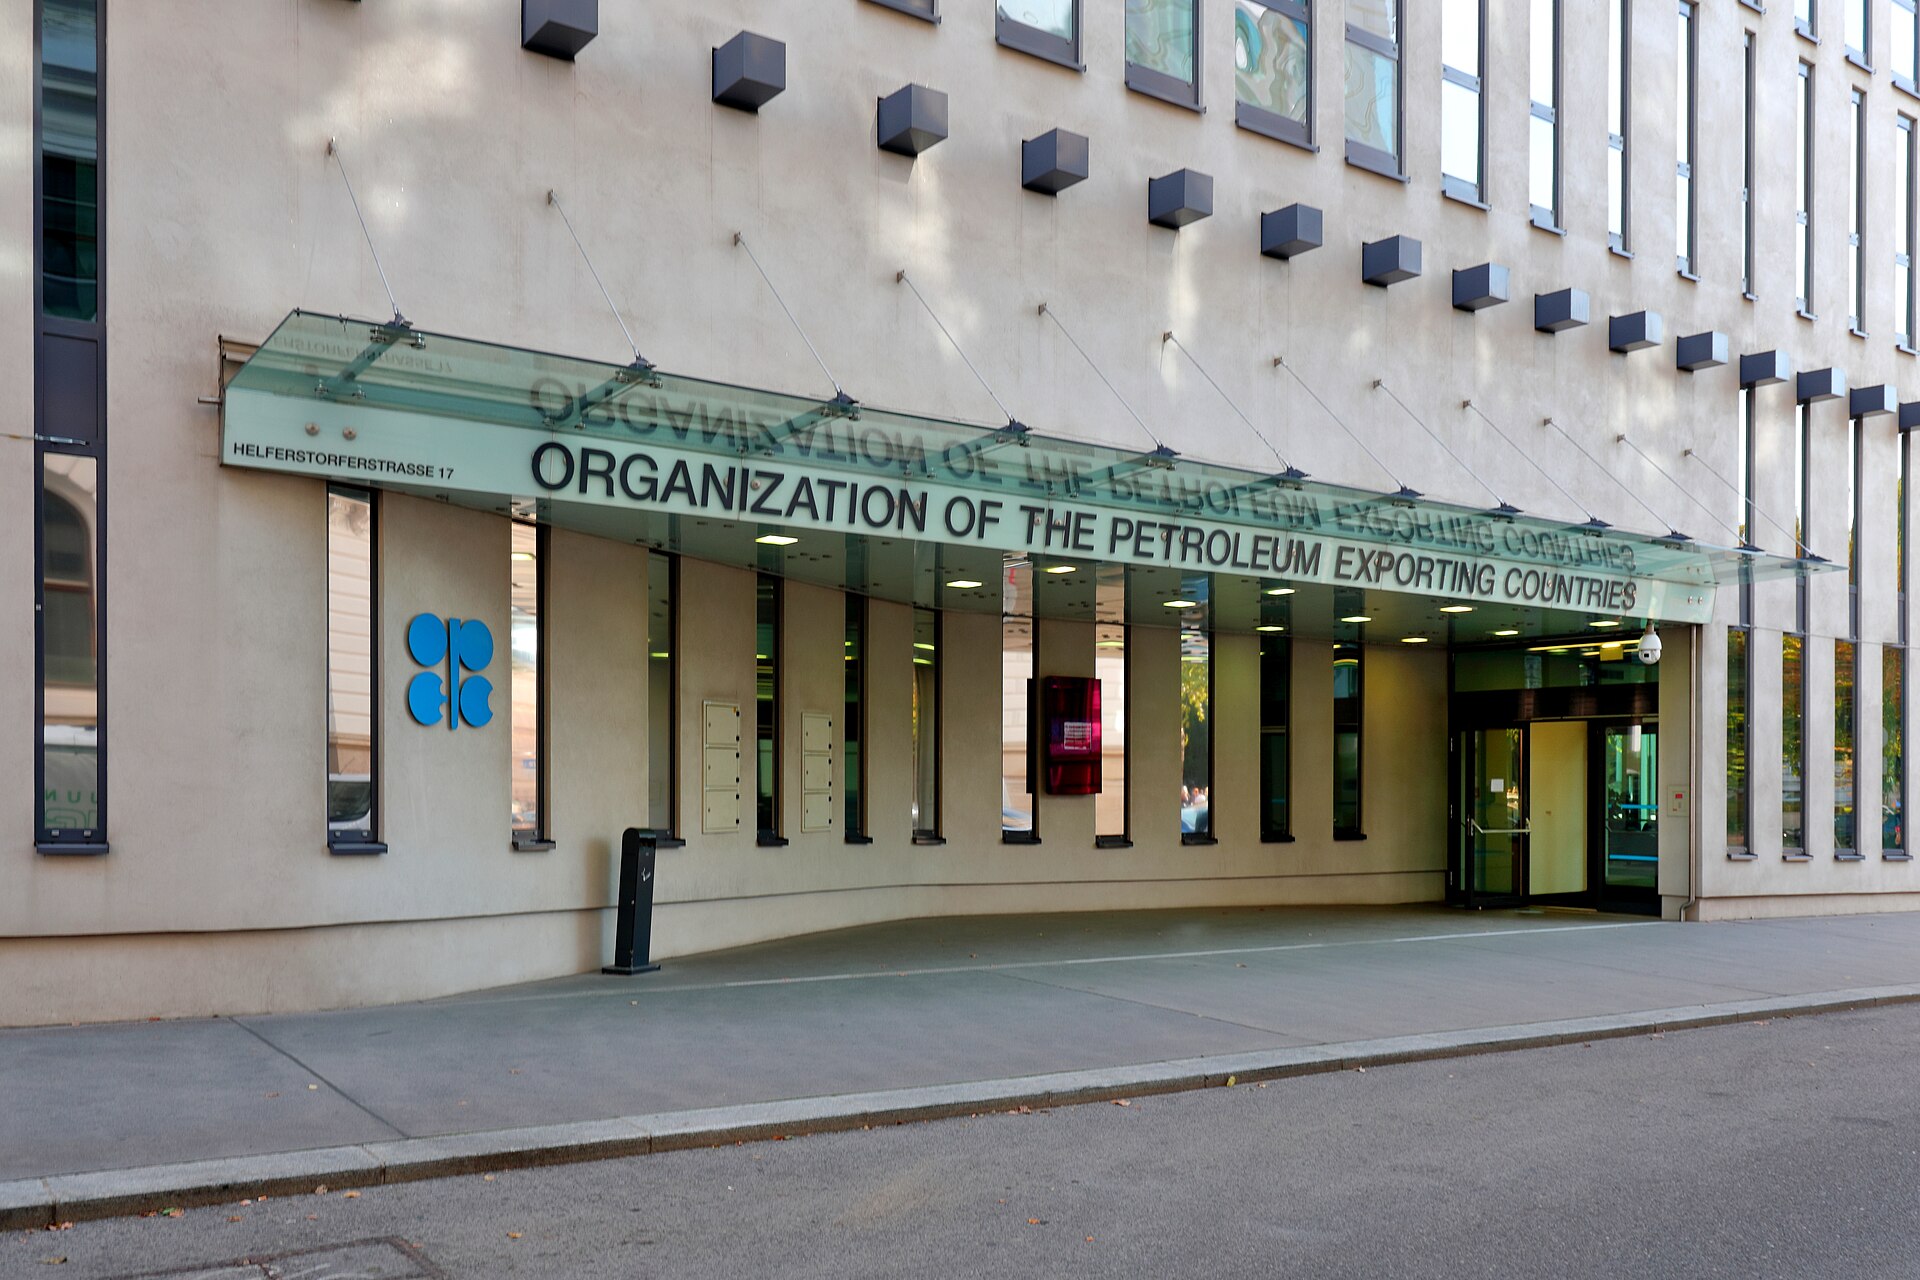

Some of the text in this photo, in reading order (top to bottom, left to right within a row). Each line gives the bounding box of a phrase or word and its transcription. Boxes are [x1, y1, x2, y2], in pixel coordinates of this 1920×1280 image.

[233, 442, 454, 479] HELFERSTORFERSTRASSE 17
[531, 441, 1637, 611] ORGANIZATION OF THE PETROLEUM EXPORTING COUNTRIES
